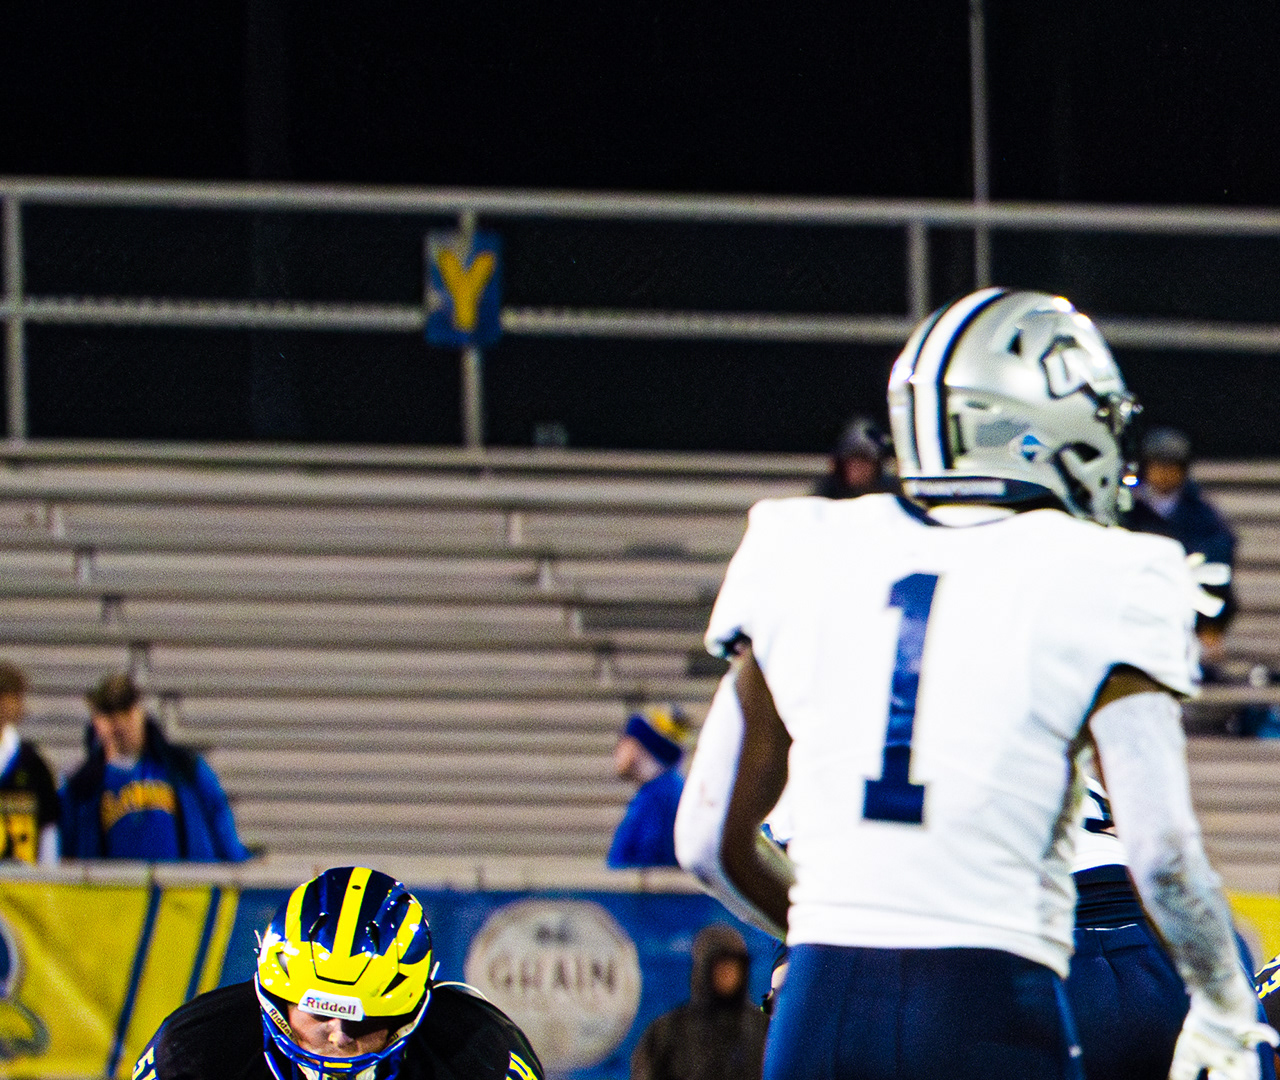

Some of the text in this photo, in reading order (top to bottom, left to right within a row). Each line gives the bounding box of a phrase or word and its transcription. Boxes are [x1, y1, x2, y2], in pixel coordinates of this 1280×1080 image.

[438, 248, 496, 332] Y
[861, 572, 940, 826] 1
[305, 995, 357, 1016] Riddell
[486, 956, 616, 996] GRAIN
